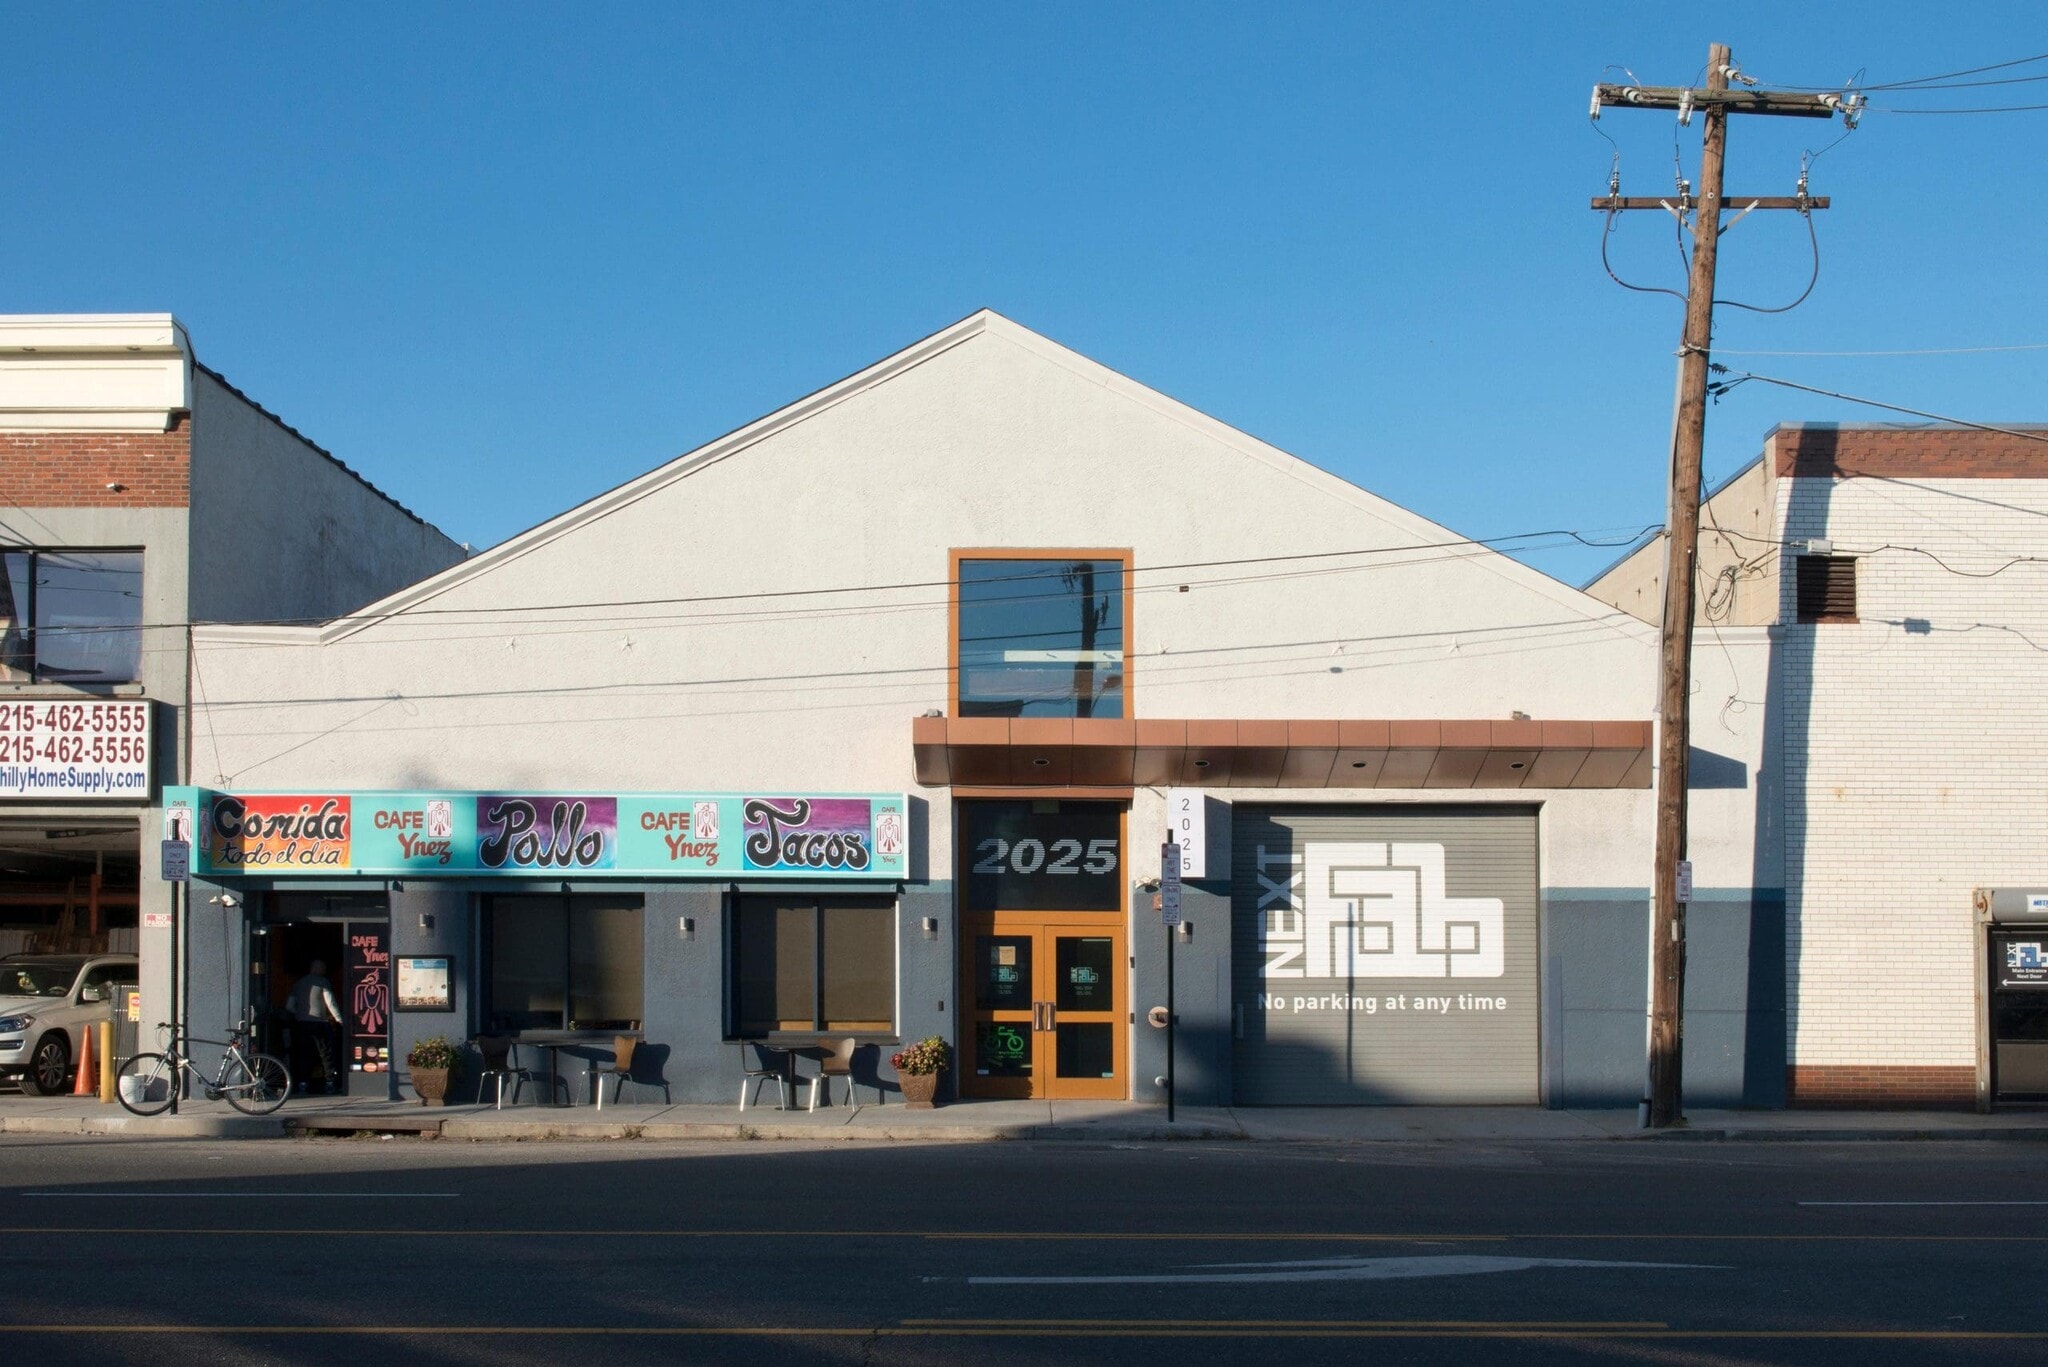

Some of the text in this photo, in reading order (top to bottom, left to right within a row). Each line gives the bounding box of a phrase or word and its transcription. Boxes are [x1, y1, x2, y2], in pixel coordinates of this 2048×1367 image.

[0, 704, 145, 732] 215-462-5555
[0, 736, 145, 763] 215-462-5556
[214, 797, 347, 839] Comida
[374, 810, 424, 829] CAFE
[641, 811, 690, 831] CAFE
[480, 800, 604, 868] Pollo
[744, 799, 870, 870] Tacos
[218, 841, 271, 865] todo
[276, 841, 294, 864] el
[398, 832, 453, 865] Ynez
[665, 833, 719, 867] Ynez
[972, 838, 1118, 874] 2025
[1257, 845, 1303, 978] NEXT
[352, 935, 379, 947] CAFE
[2007, 942, 2016, 967] NEXT
[1258, 993, 1507, 1014] No parking at any time
